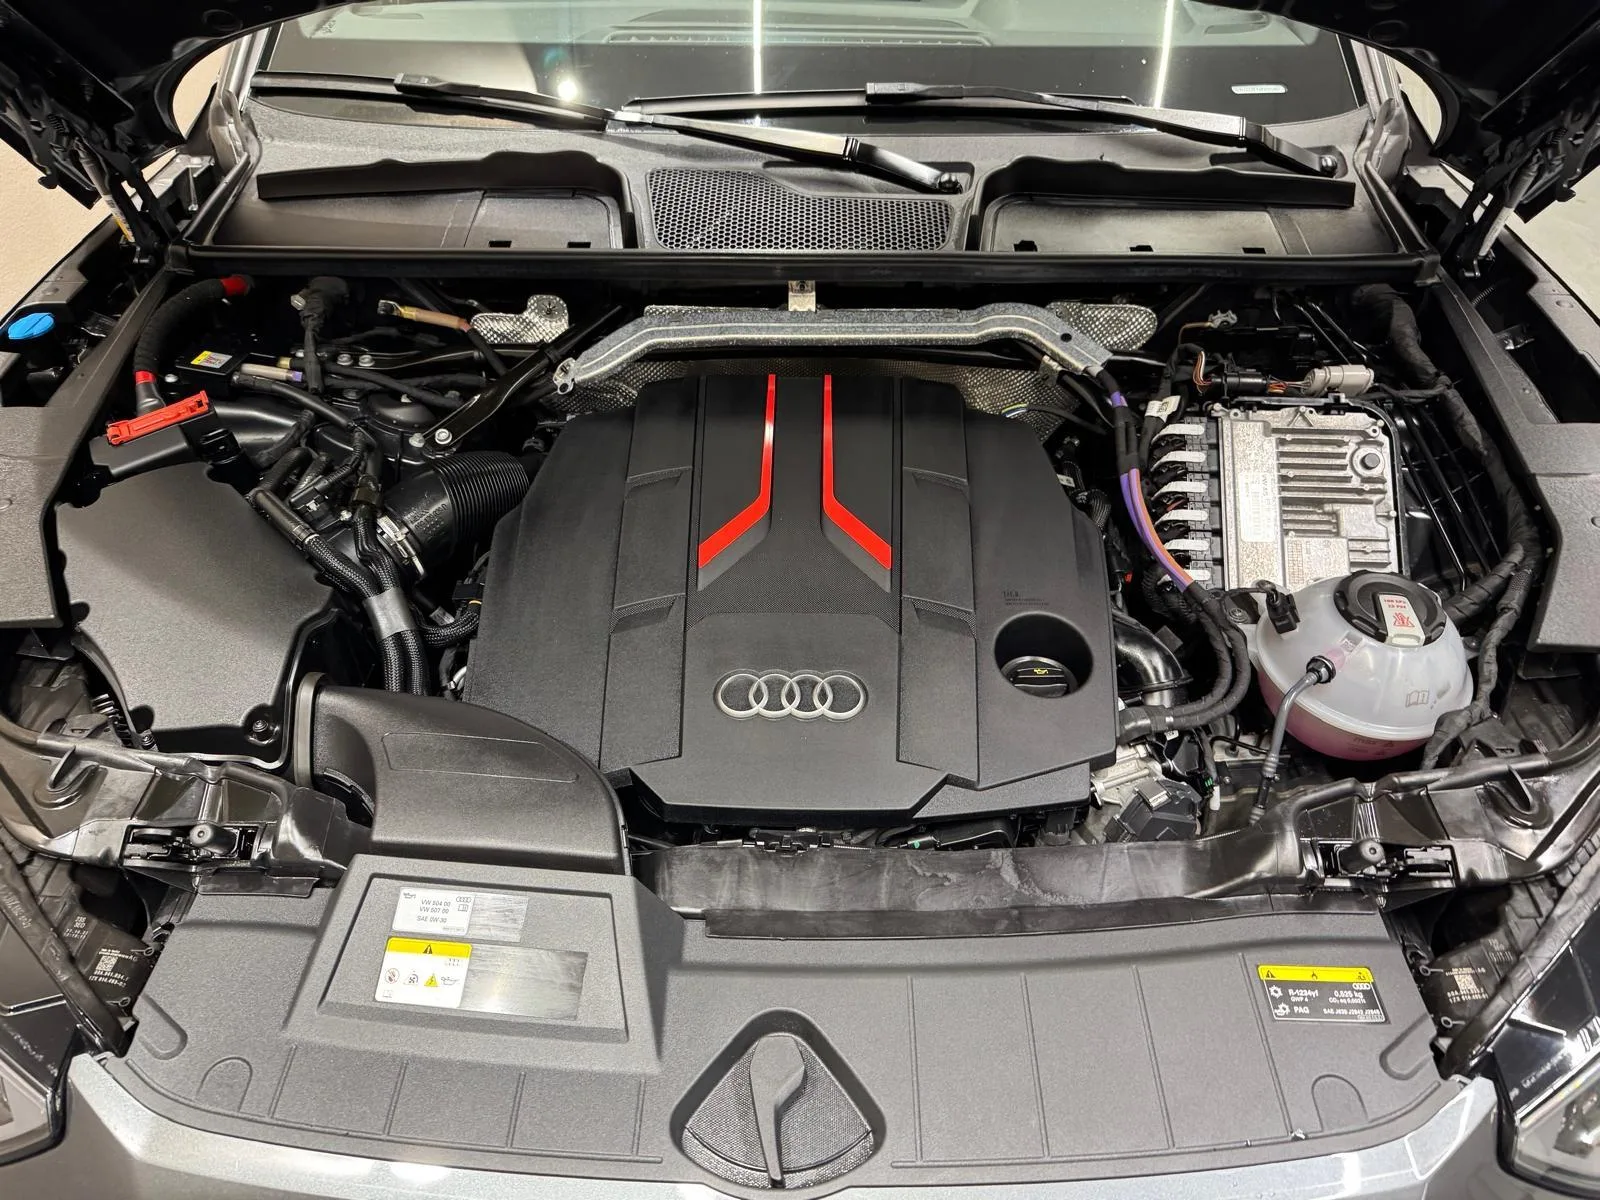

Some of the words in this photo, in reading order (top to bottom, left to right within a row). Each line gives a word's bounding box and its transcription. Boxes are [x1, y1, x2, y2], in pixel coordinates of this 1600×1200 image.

[1288, 989, 1319, 998] R-1234yf
[1353, 991, 1363, 999] kg
[1293, 1006, 1310, 1014] PAG
